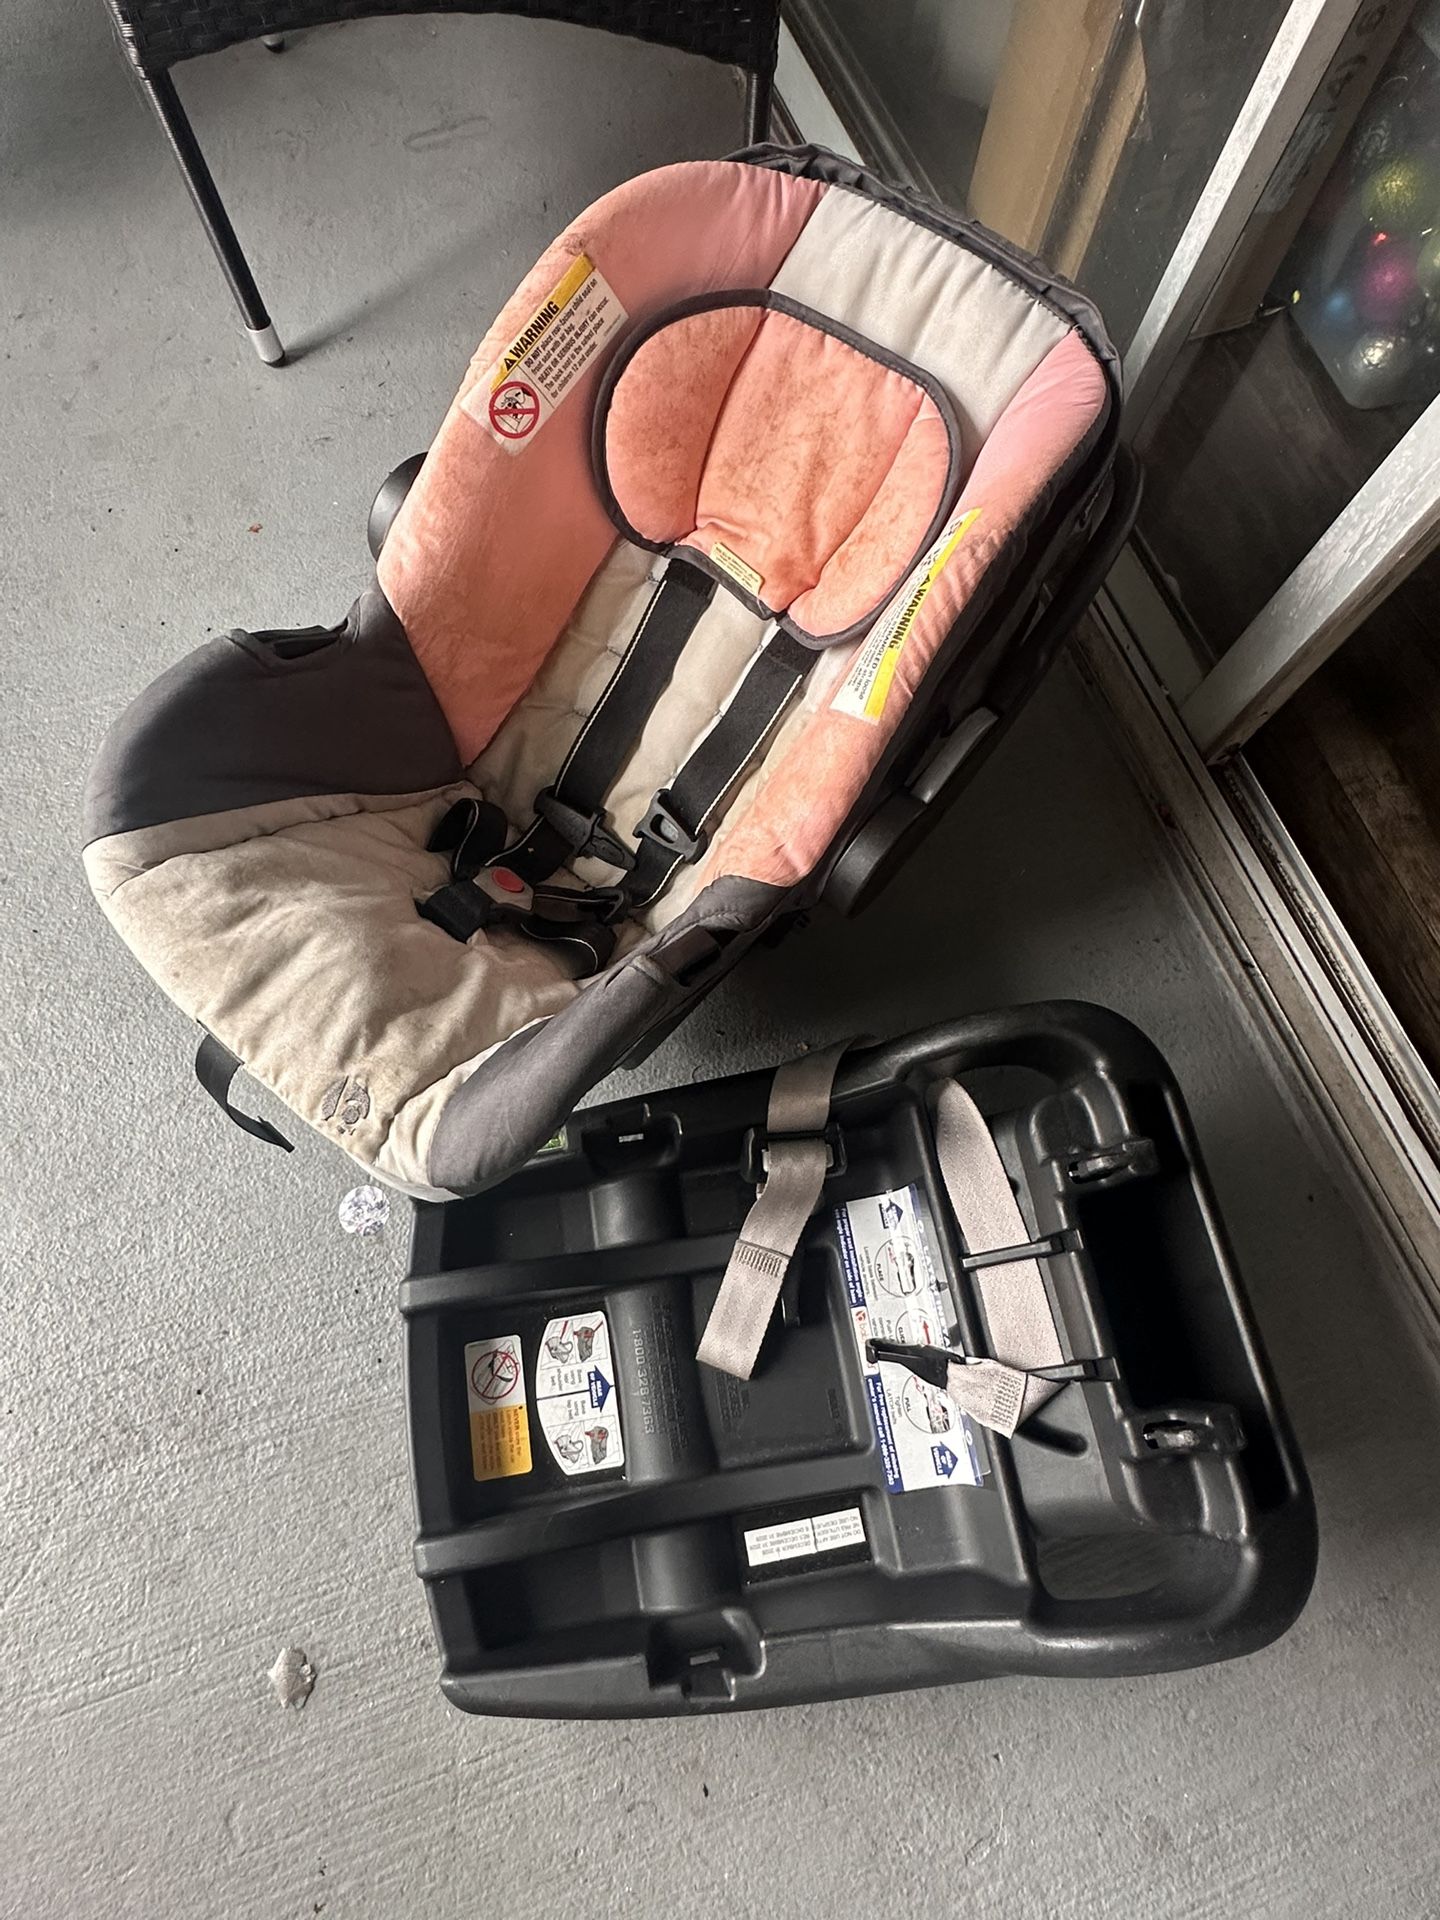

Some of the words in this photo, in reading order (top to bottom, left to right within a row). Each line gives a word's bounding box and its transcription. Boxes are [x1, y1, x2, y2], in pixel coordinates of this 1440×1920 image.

[509, 301, 560, 361] WARNING
[524, 356, 533, 368] DO
[530, 345, 542, 360] NOT
[539, 332, 553, 351] place
[571, 294, 583, 311] child
[580, 283, 592, 299] seat
[537, 364, 553, 383] DEATH
[550, 356, 559, 367] OR
[556, 335, 575, 360] SERIOUS
[573, 318, 590, 340] INJURY
[588, 310, 597, 322] can
[541, 349, 552, 363] seat
[544, 378, 554, 391] The
[551, 367, 563, 382] back
[571, 363, 578, 372] 12
[888, 588, 927, 648] WARNING
[886, 1388, 894, 1409] LATCH
[893, 1395, 903, 1416] Tighten
[880, 1406, 892, 1445] replacement
[932, 1447, 942, 1473] VEHICLE
